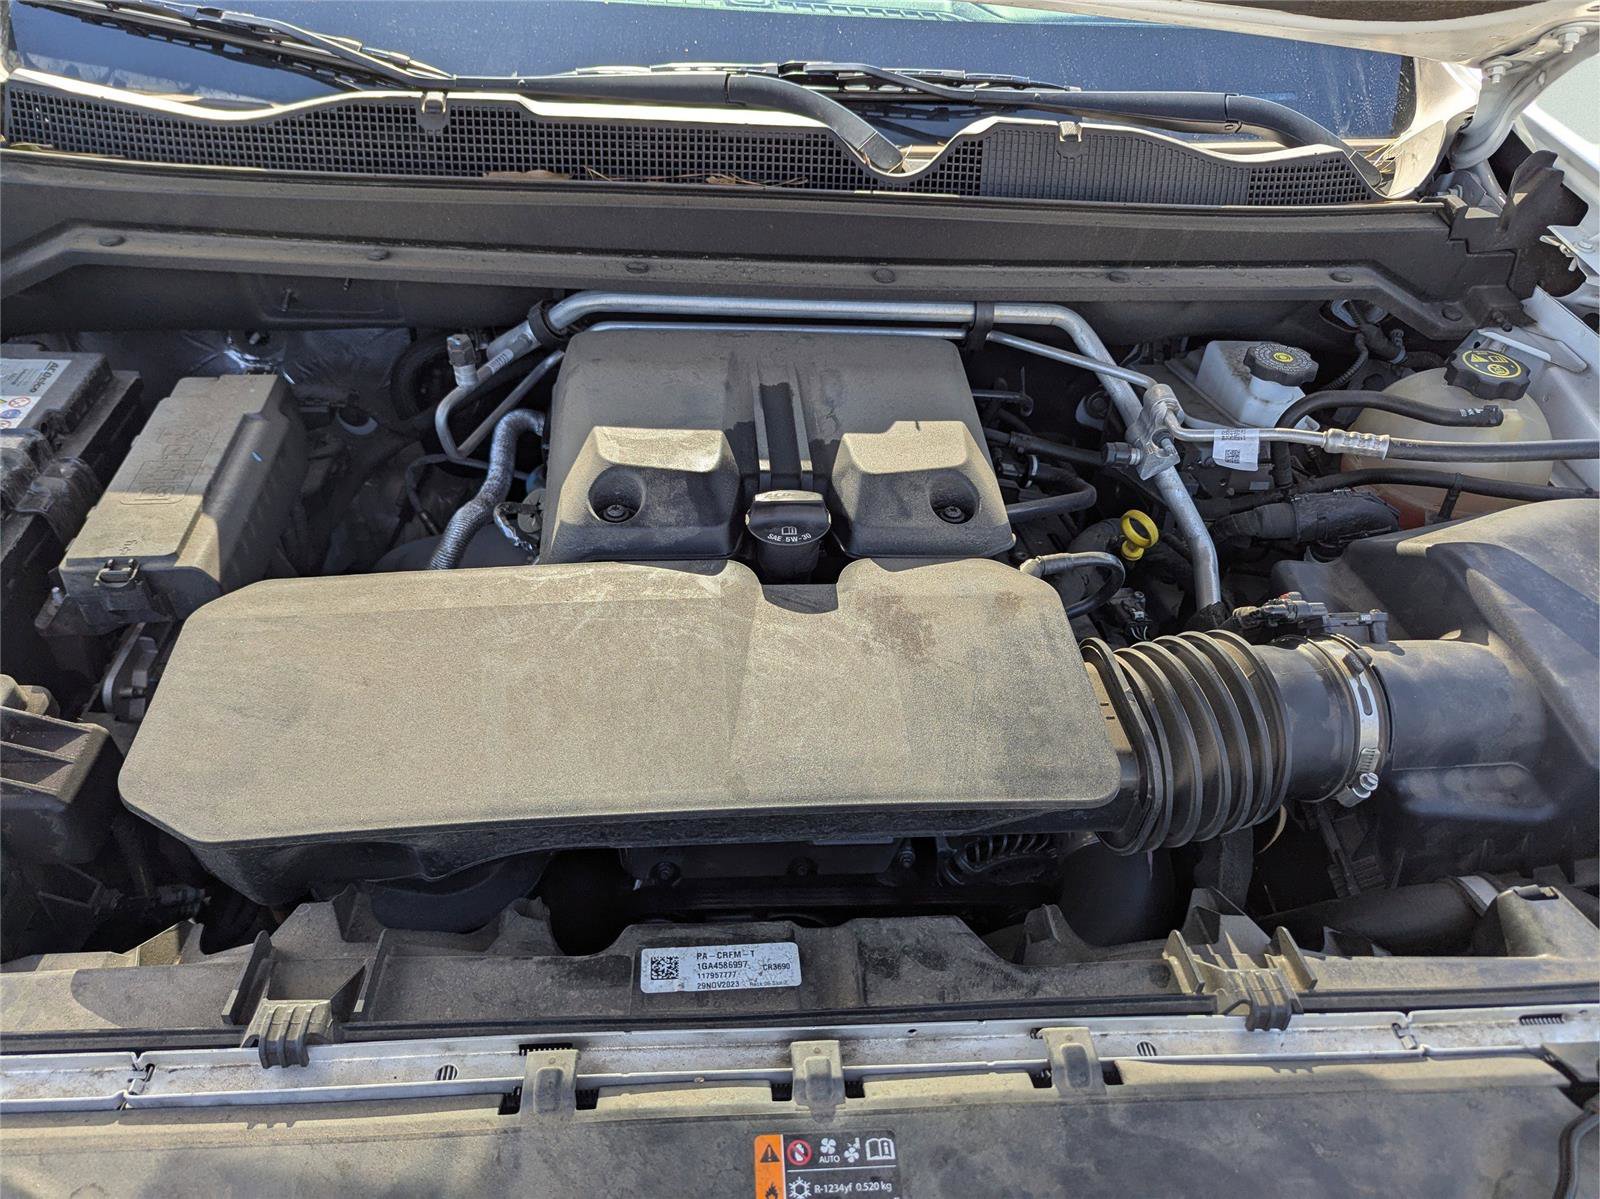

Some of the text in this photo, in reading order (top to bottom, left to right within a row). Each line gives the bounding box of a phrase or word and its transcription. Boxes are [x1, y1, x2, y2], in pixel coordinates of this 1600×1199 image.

[767, 533, 811, 542] SAE 5W-30
[697, 961, 748, 970] 1GA4586997
[763, 962, 791, 971] CR3690
[697, 971, 737, 979] 117957777
[697, 981, 740, 990] 29NOV2023
[819, 1155, 840, 1163] AUTO
[814, 1181, 892, 1193] R-1234yf 0.520 kg
